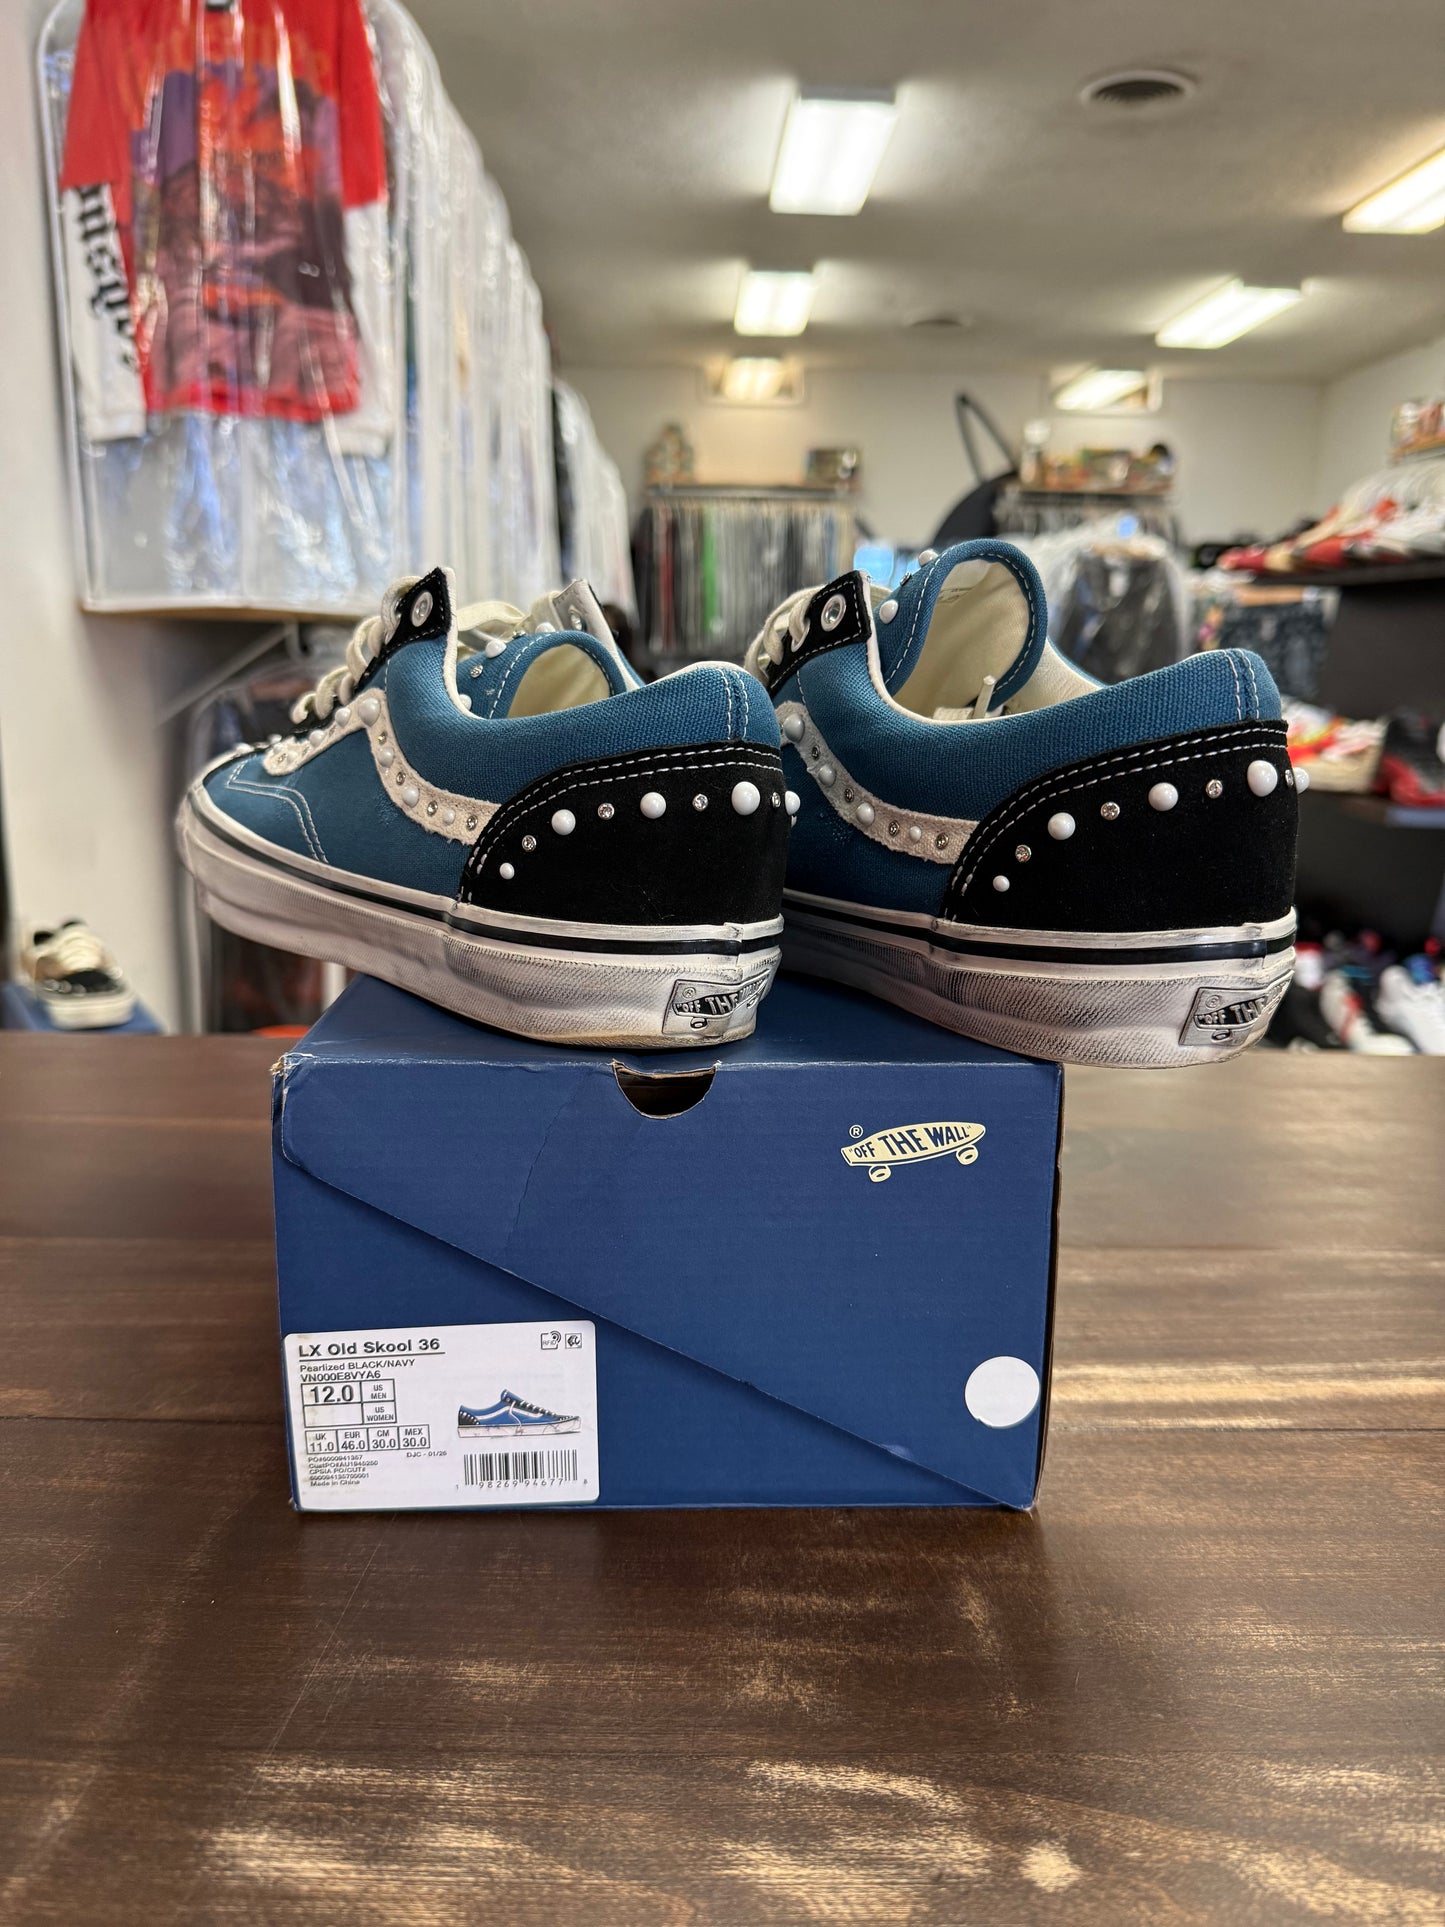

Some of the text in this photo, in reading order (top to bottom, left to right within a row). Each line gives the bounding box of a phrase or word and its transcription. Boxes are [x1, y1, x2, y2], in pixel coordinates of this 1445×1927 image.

[878, 1129, 928, 1156] THE
[299, 1338, 440, 1357] LX Old Skool 36
[300, 1359, 415, 1372] Pearlized BLACK/NAVY
[300, 1370, 381, 1382] VN000E8VYA6
[310, 1385, 354, 1403] 12.0
[344, 1431, 360, 1439] EUR
[405, 1428, 423, 1436] MEX
[310, 1441, 334, 1452] 11.0
[341, 1440, 365, 1450] 46.0
[372, 1438, 396, 1448] 30.0
[403, 1437, 427, 1447] 30.0
